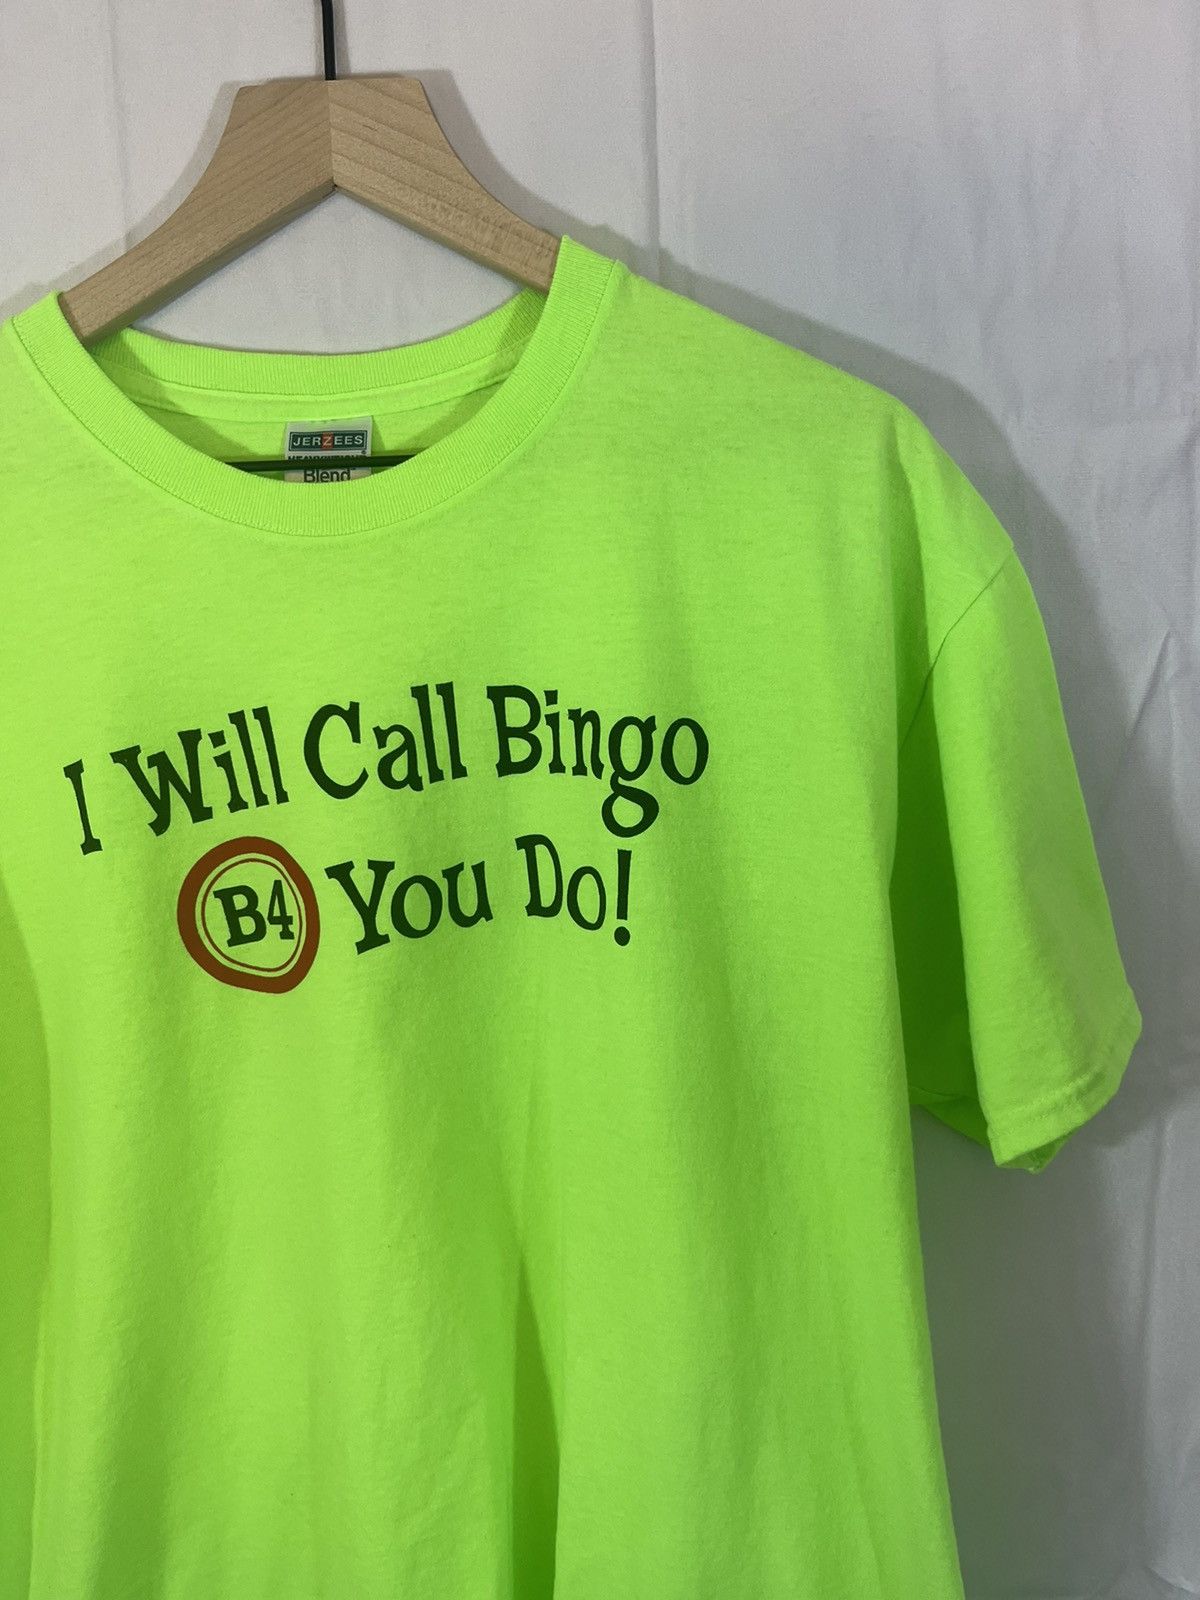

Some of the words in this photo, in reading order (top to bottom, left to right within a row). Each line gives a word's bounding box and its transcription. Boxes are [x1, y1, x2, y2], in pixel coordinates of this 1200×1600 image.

[293, 434, 364, 447] JERZEES
[64, 759, 103, 856] I
[110, 706, 289, 837] Will
[304, 681, 468, 800] Call
[486, 685, 710, 839] Bingo
[213, 880, 295, 948] B4
[324, 859, 494, 956] You
[515, 834, 633, 947] Do!
